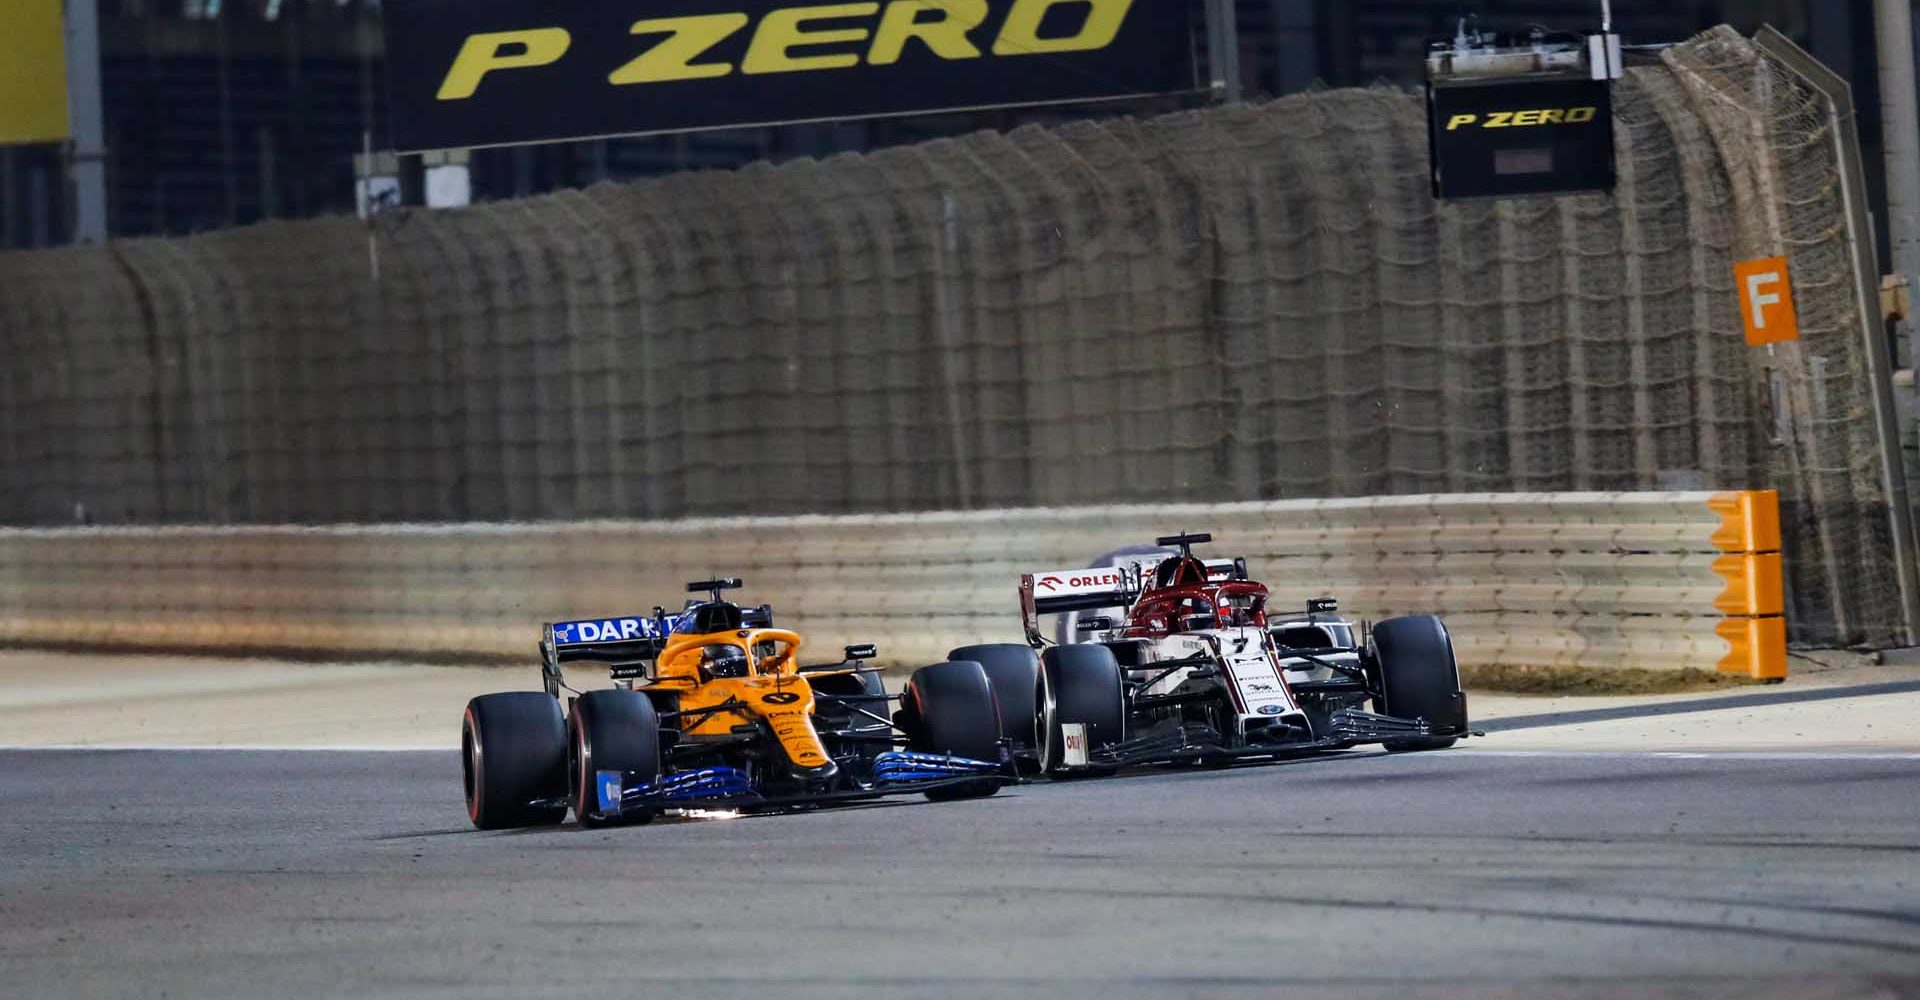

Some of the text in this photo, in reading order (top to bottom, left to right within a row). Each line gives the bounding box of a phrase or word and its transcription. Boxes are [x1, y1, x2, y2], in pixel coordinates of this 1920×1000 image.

[436, 0, 1133, 100] P ZERO
[1445, 105, 1598, 131] P ZERO
[1746, 271, 1780, 329] F
[1232, 637, 1249, 654] 7
